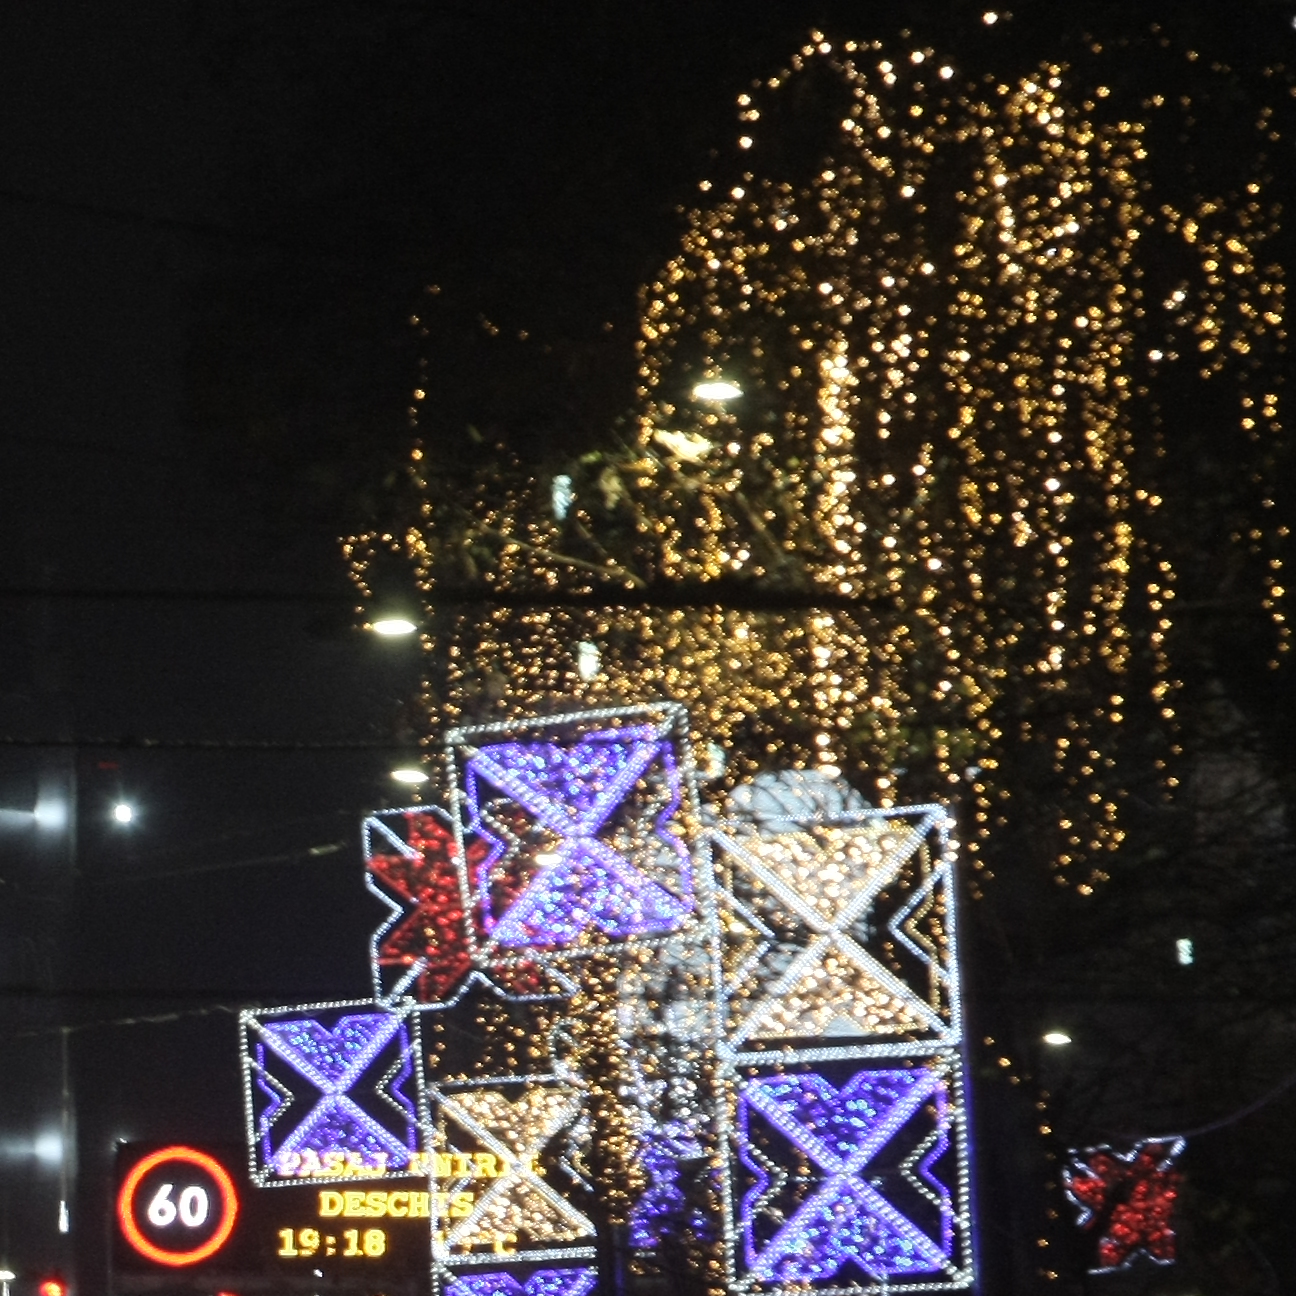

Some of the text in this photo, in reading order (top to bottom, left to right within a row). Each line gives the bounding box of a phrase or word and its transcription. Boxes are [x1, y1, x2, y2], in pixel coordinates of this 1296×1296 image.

[146, 1183, 210, 1229] 60
[318, 1190, 475, 1218] DESCHIS
[277, 1227, 387, 1257] 19:18
